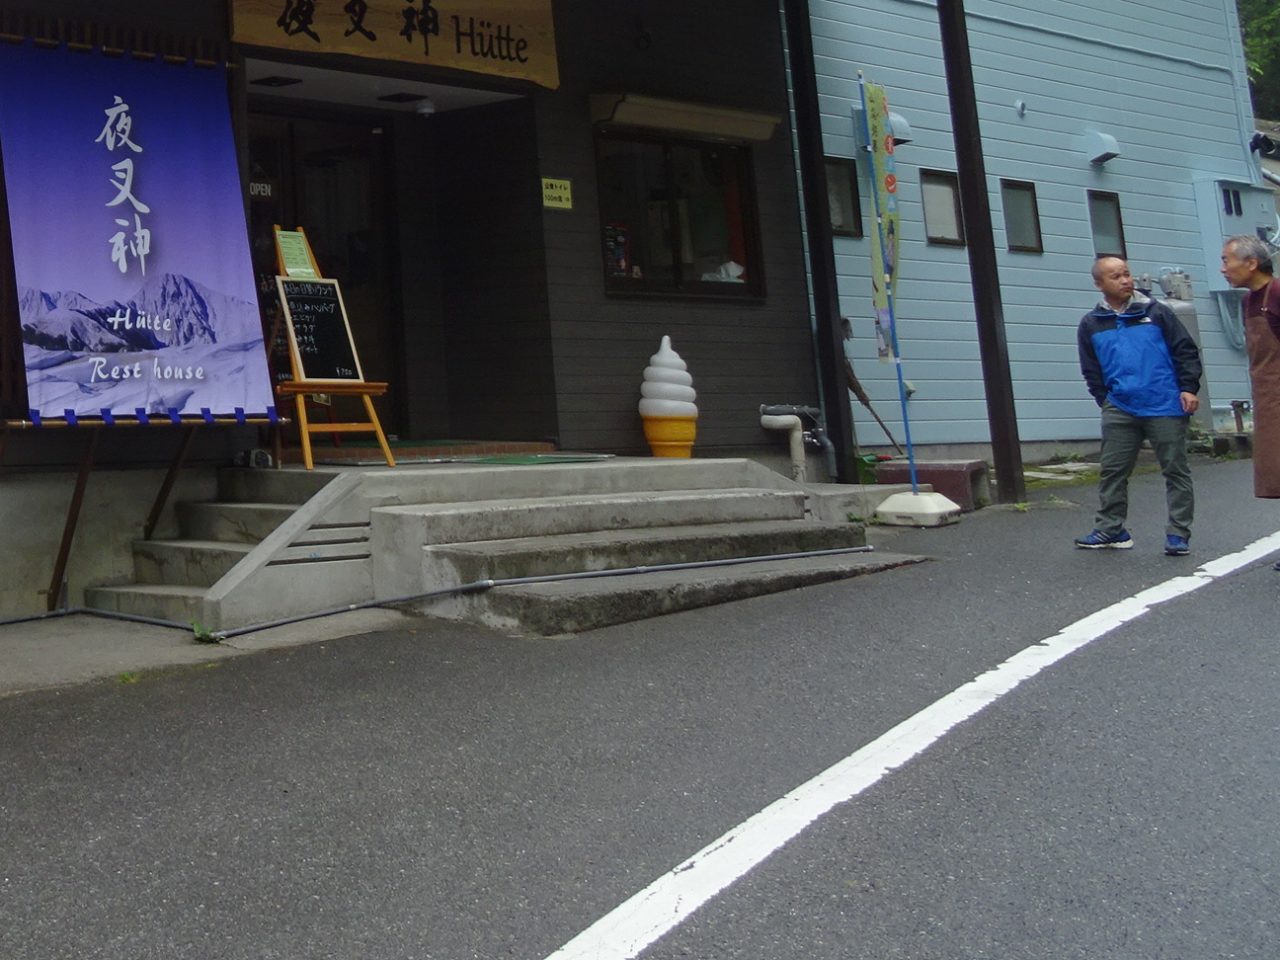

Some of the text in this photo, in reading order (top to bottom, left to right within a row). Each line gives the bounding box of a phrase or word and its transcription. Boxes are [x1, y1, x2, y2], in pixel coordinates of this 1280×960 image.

[450, 15, 530, 64] Hütte
[94, 95, 151, 277] 夜叉神
[249, 182, 272, 197] OPEN
[107, 308, 172, 332] Hütte
[89, 356, 205, 384] Rest house
